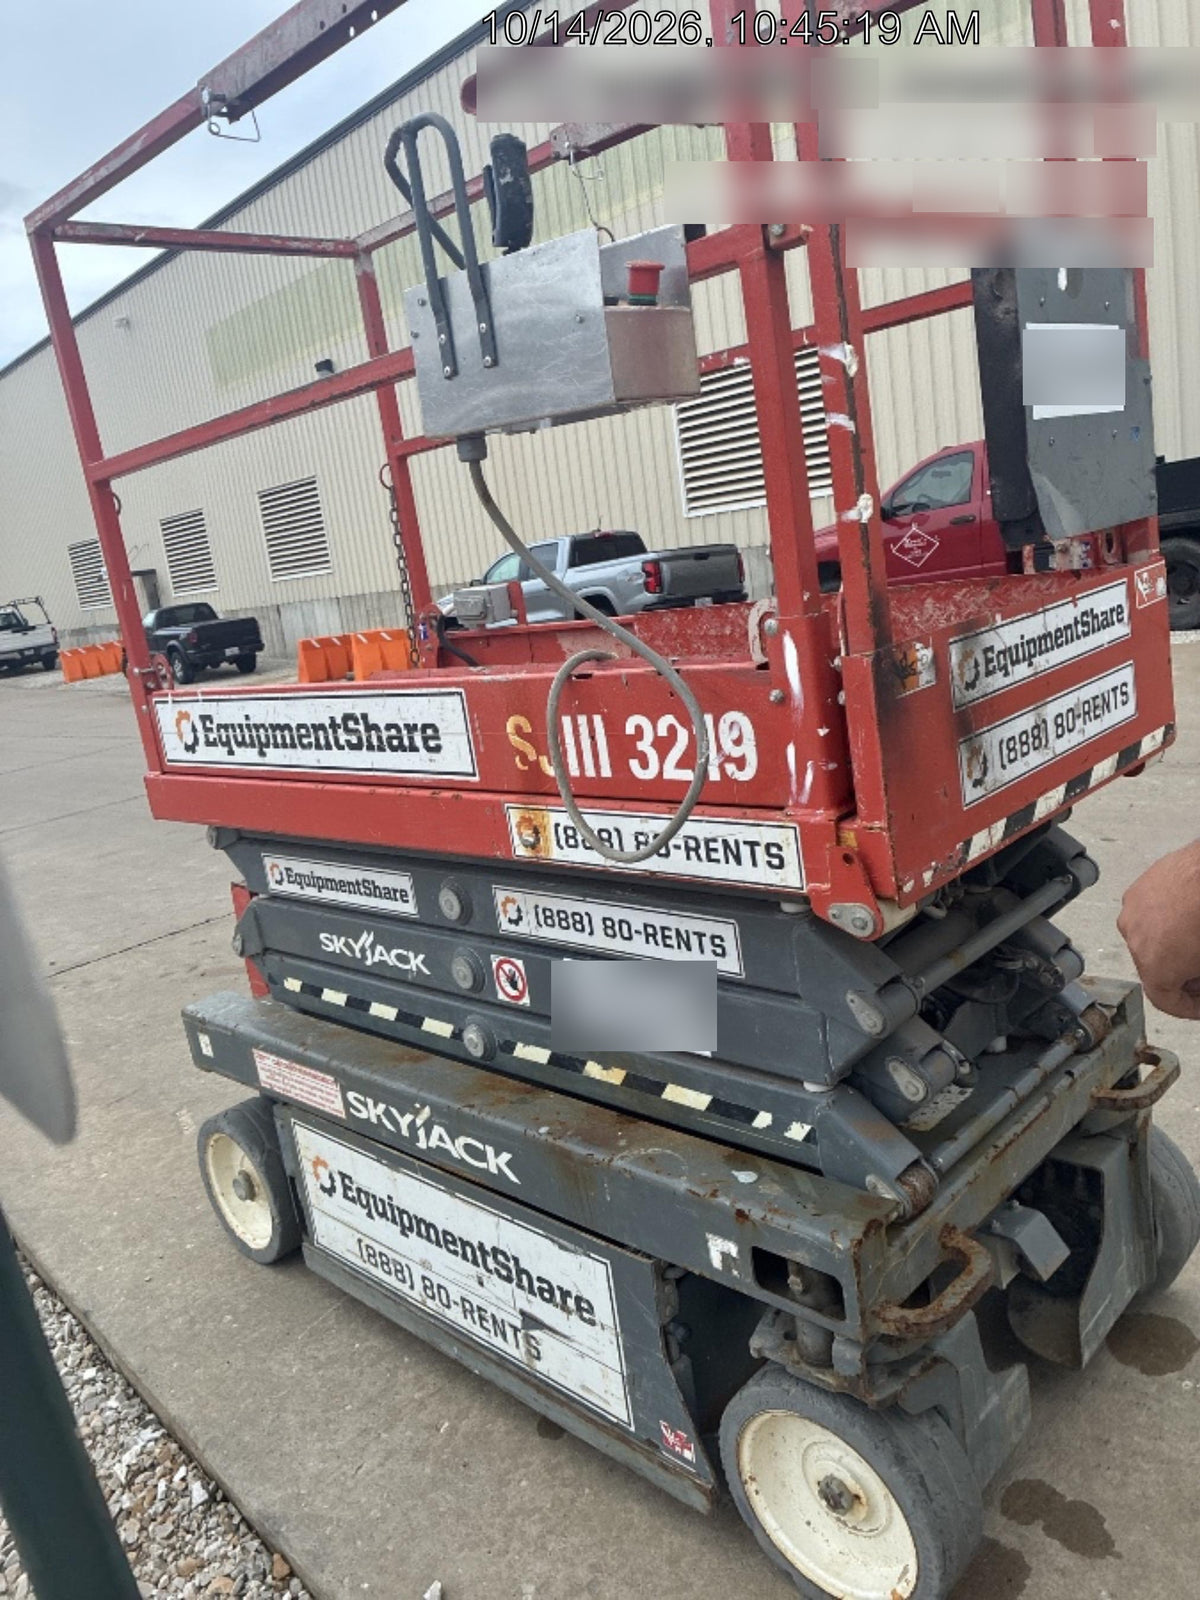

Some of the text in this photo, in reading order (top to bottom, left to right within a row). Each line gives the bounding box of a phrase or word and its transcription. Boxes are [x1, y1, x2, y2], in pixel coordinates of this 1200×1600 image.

[982, 602, 1125, 678] EquipmentShare
[199, 712, 443, 757] EquipmentShare
[625, 710, 758, 781] 3219
[999, 681, 1129, 770] (888) 80-RENTS
[283, 866, 411, 904] EquipmentShare
[319, 930, 431, 975] SKYJACK
[534, 903, 728, 958] (888) 80-RENTS
[346, 1090, 521, 1186] SKYJACK
[337, 1170, 597, 1327] EquipmentShare
[356, 1238, 542, 1361] (888) 80-RENTS
